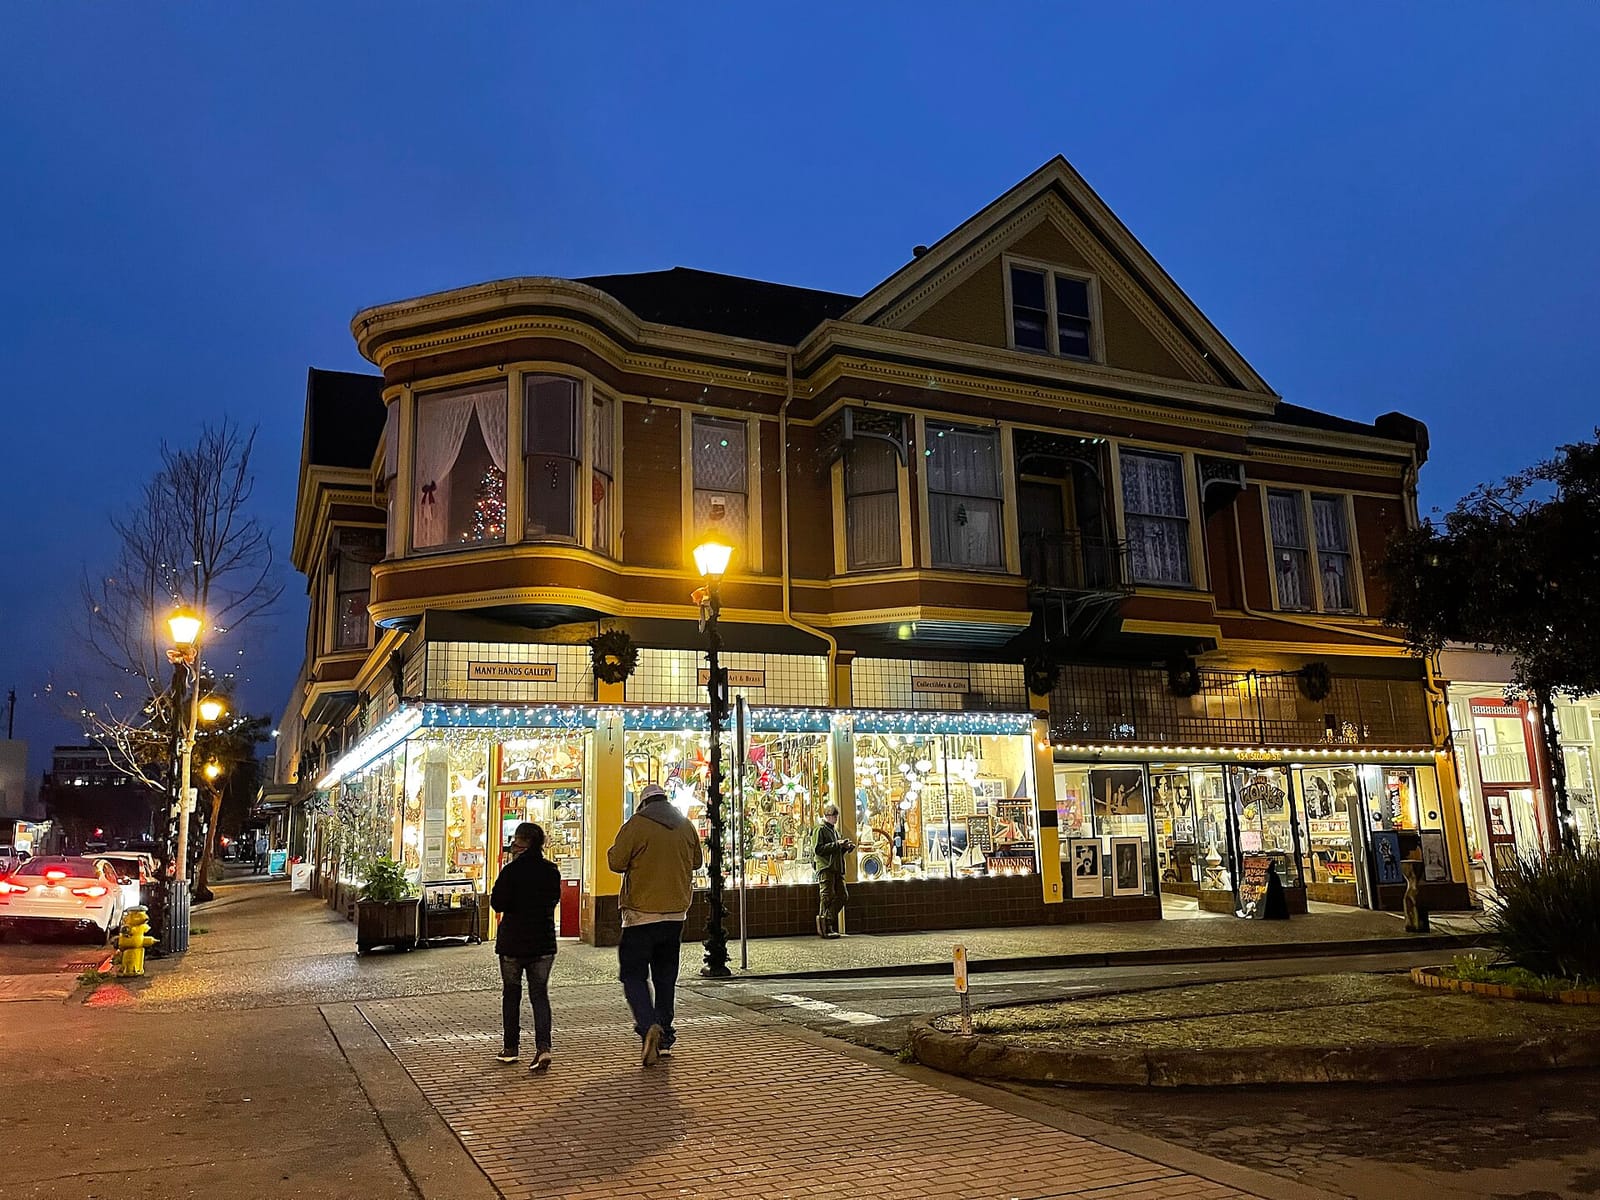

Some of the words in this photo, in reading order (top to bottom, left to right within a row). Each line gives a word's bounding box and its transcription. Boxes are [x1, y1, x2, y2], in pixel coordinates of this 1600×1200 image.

[475, 666, 496, 675] MANY
[498, 667, 522, 676] HANDS
[524, 667, 552, 677] GALLERY
[1239, 784, 1285, 809] WORKS
[990, 857, 1033, 867] WARNING
